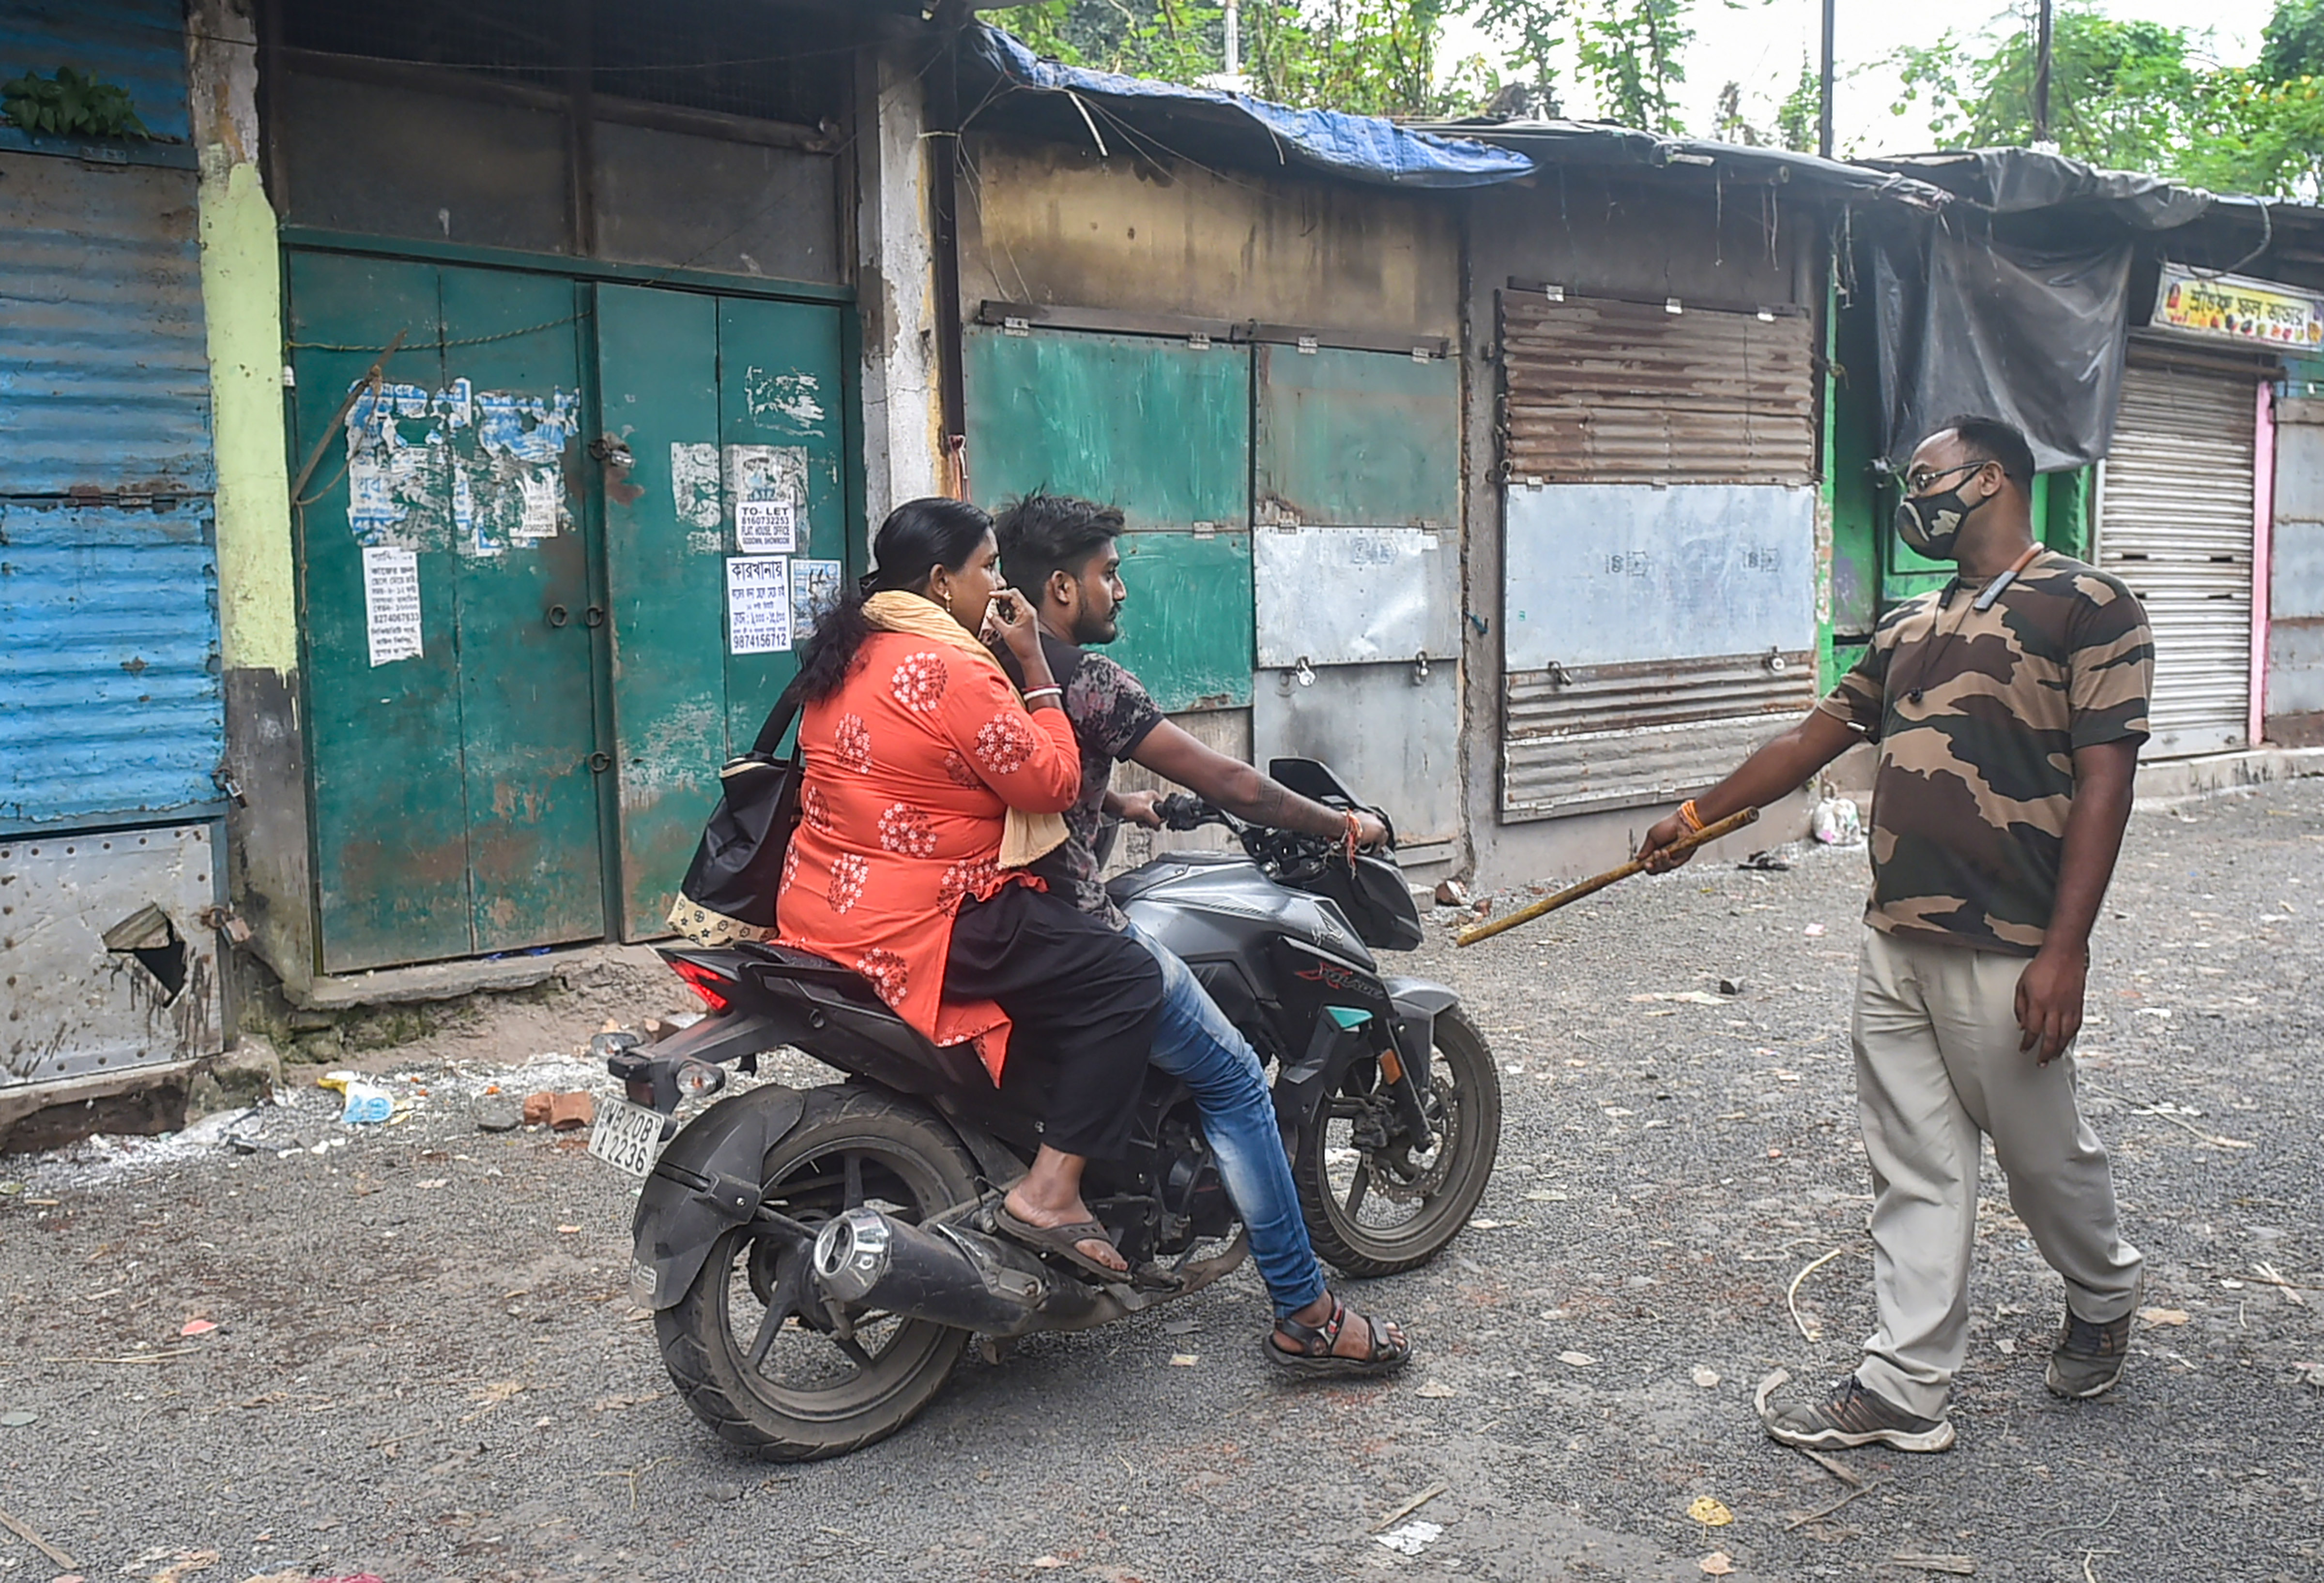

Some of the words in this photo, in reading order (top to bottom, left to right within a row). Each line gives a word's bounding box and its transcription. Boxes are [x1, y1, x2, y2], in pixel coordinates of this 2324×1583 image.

[766, 506, 790, 516] LET
[730, 560, 783, 581] কারখানায়
[733, 633, 787, 649] 9874156712
